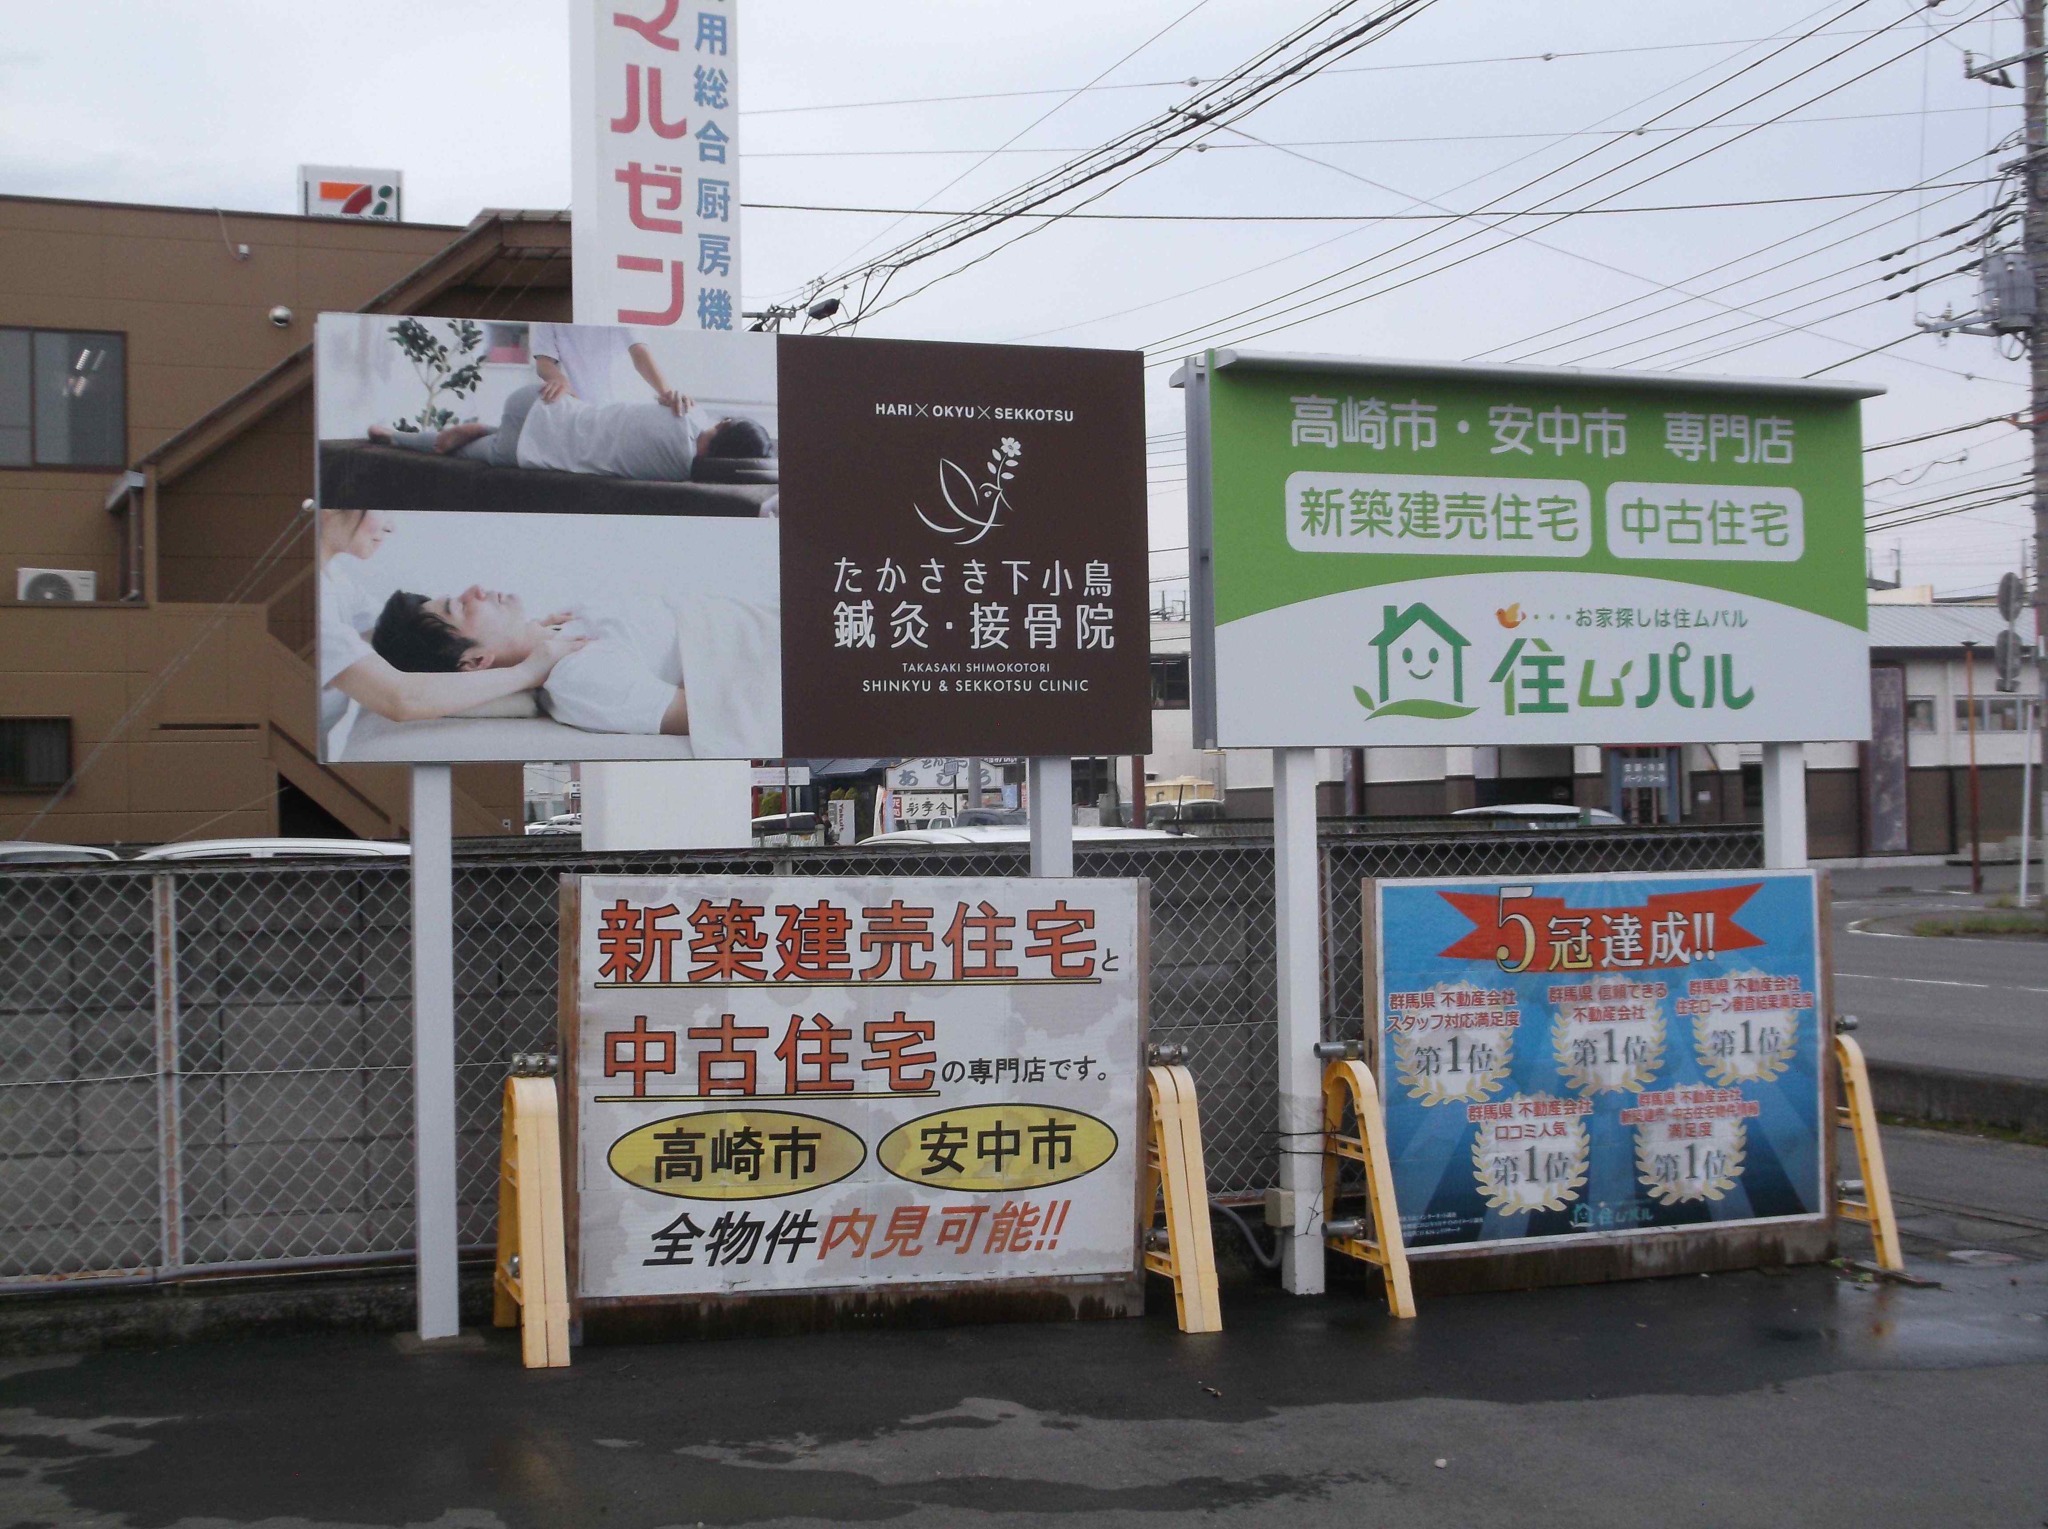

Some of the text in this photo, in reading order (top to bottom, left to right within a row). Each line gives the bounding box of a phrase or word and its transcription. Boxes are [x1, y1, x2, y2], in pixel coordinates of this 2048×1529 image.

[610, 0, 688, 327] マルゼン
[694, 0, 733, 331] 用総合厨房機
[994, 407, 1075, 422] SEKKOTSU
[1290, 394, 1795, 465] 高崎市・安中市 専門店
[1300, 486, 1579, 542] 新築建売住宅
[1621, 496, 1790, 547] 中古住宅
[833, 556, 1112, 598] たかさき下小鳥
[833, 599, 1115, 650] 鍼灸・接骨院
[862, 679, 1089, 692] SHINKYU & SEKKOTSU CLINIC
[902, 662, 1050, 673] TAKASAKI SHIMOKOTORI
[1489, 637, 1755, 716] 住ムパル
[1389, 989, 1517, 1010] 群馬県 不動産会社
[1549, 982, 1667, 1003] 群馬県 信頼できる
[1689, 975, 1800, 996] 群馬県 不動産会社
[1387, 1011, 1520, 1032] スタッフ対応満足度
[1573, 1005, 1646, 1022] 不動産会社
[1414, 1035, 1493, 1076] 第1位
[1572, 1028, 1648, 1066] 第1位
[1711, 1020, 1781, 1057] 第1位
[1468, 1098, 1593, 1121] 群馬県 不動産会社
[920, 1118, 1077, 1176] 安中市
[1668, 1121, 1712, 1138] 満足度
[653, 1125, 821, 1184] 高崎市
[1492, 1145, 1569, 1185] 第1位
[1655, 1143, 1727, 1182] 第1位
